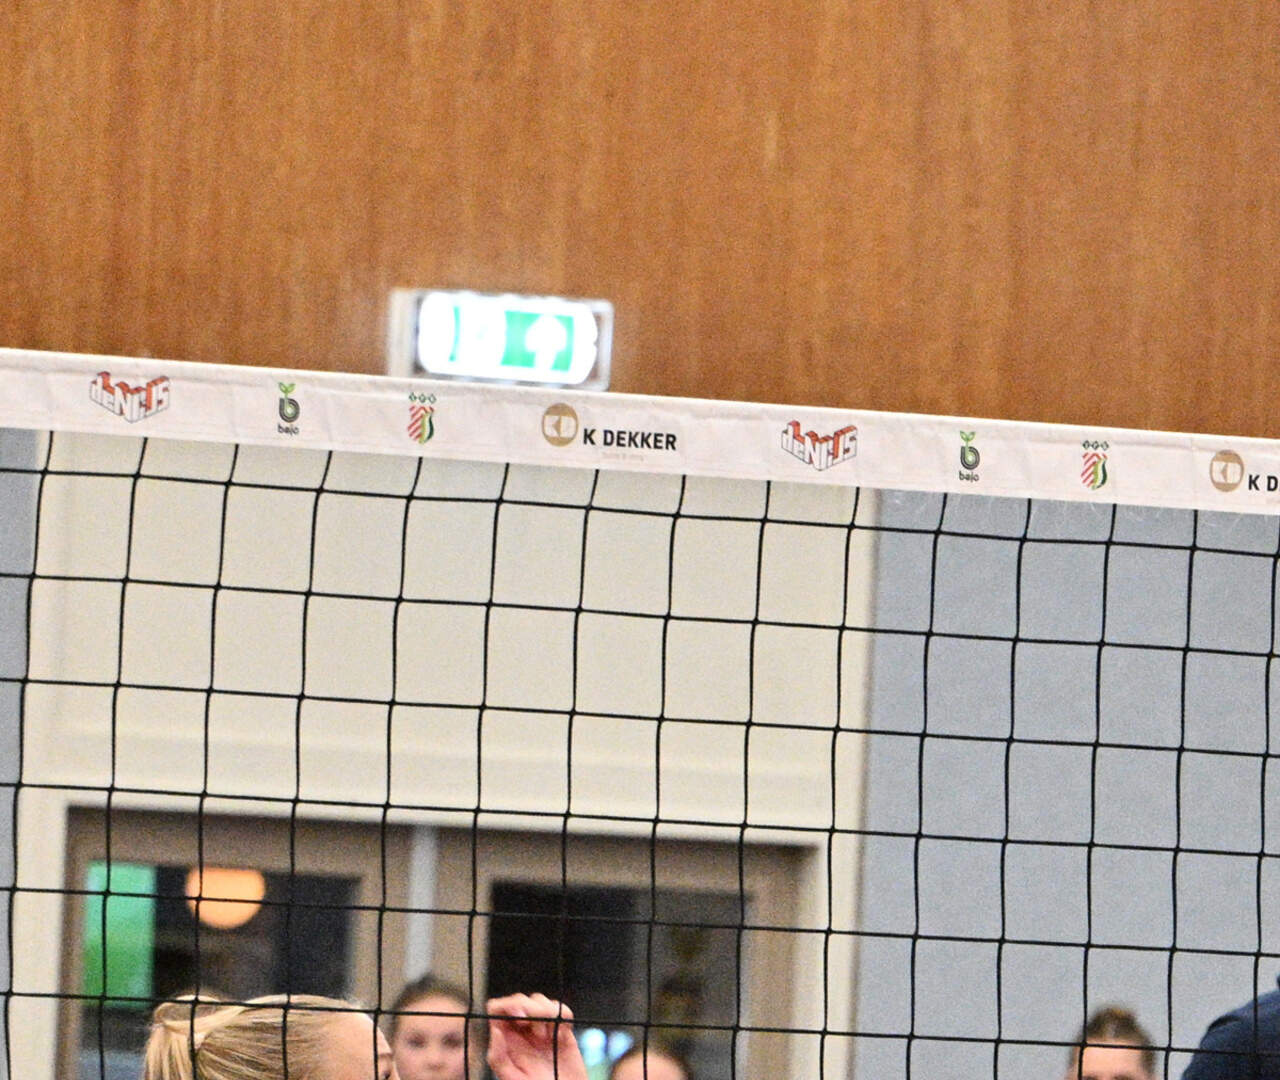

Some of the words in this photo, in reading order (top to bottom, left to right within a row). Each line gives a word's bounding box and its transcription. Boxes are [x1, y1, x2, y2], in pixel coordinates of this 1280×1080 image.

[583, 428, 596, 445] K
[603, 429, 677, 451] DEKKER
[1248, 474, 1260, 492] K
